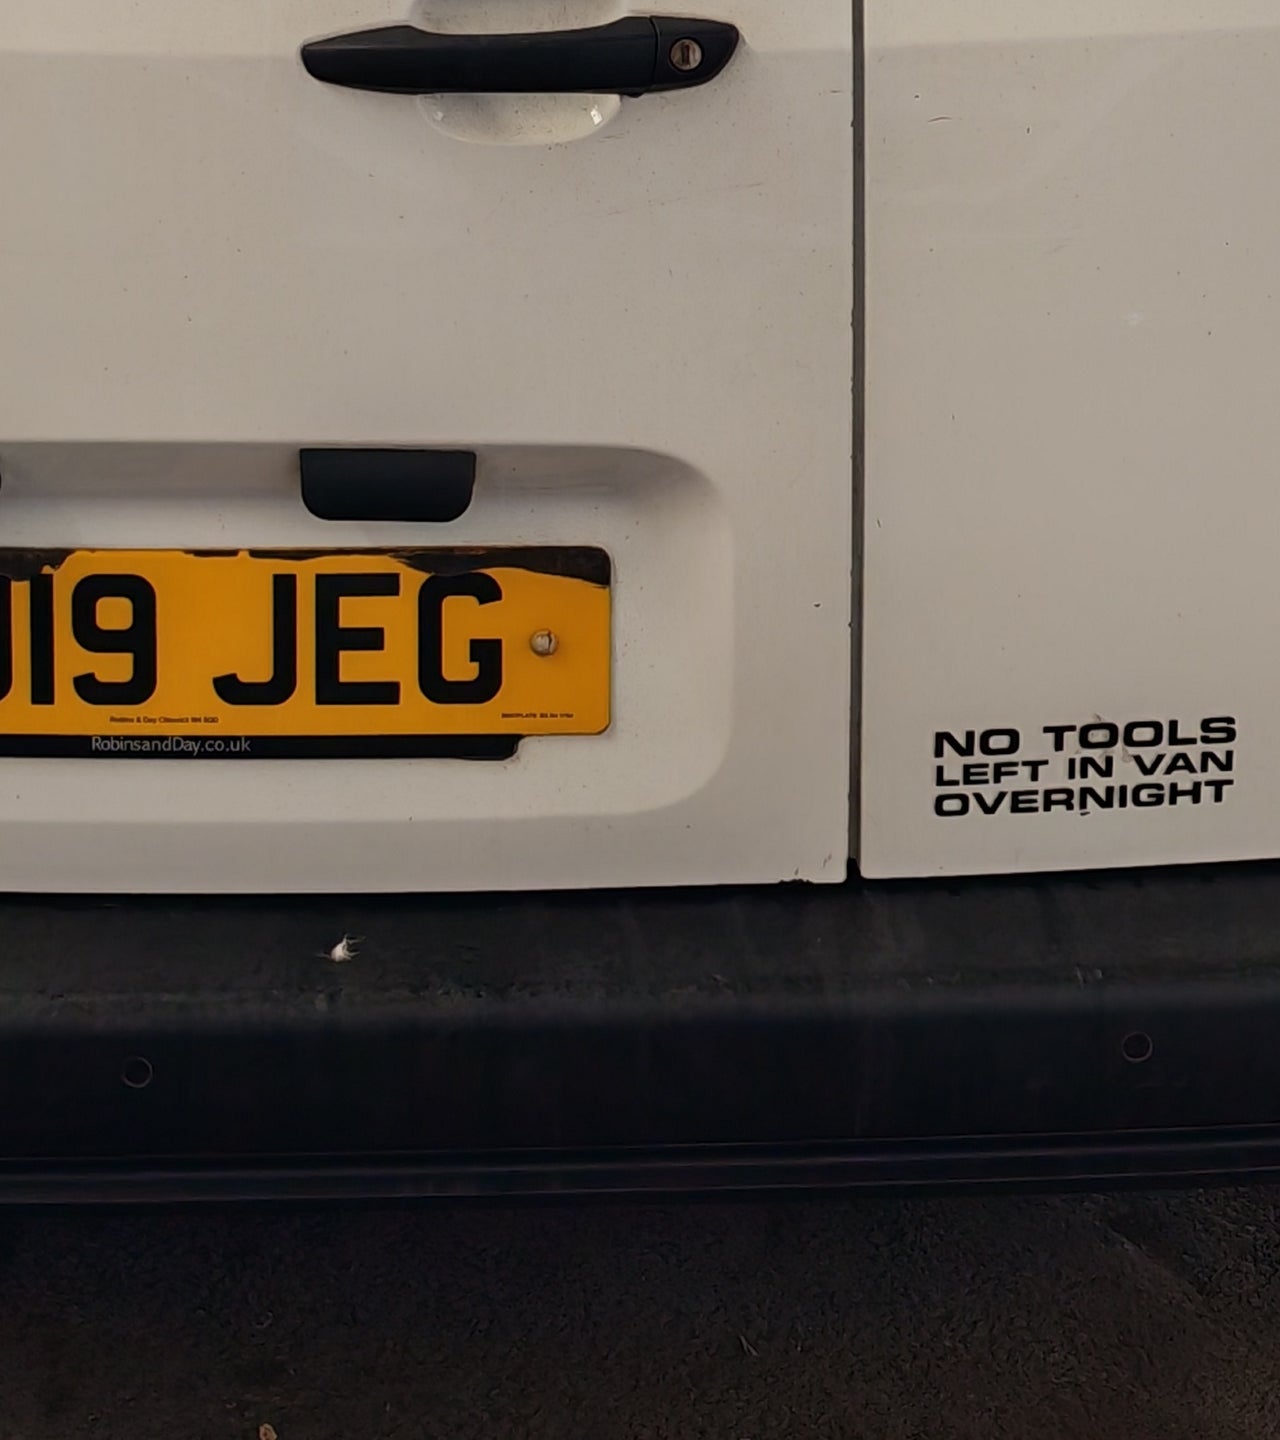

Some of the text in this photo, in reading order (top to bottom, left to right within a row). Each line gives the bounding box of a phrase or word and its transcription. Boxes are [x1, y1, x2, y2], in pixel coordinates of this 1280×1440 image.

[212, 571, 503, 705] JEG
[91, 736, 252, 756] RobinsandDay.co.uk
[934, 716, 1237, 758] NO TOOLS
[935, 750, 1234, 786] LEFT IN VAN
[933, 779, 1234, 817] OVERNIGHT
